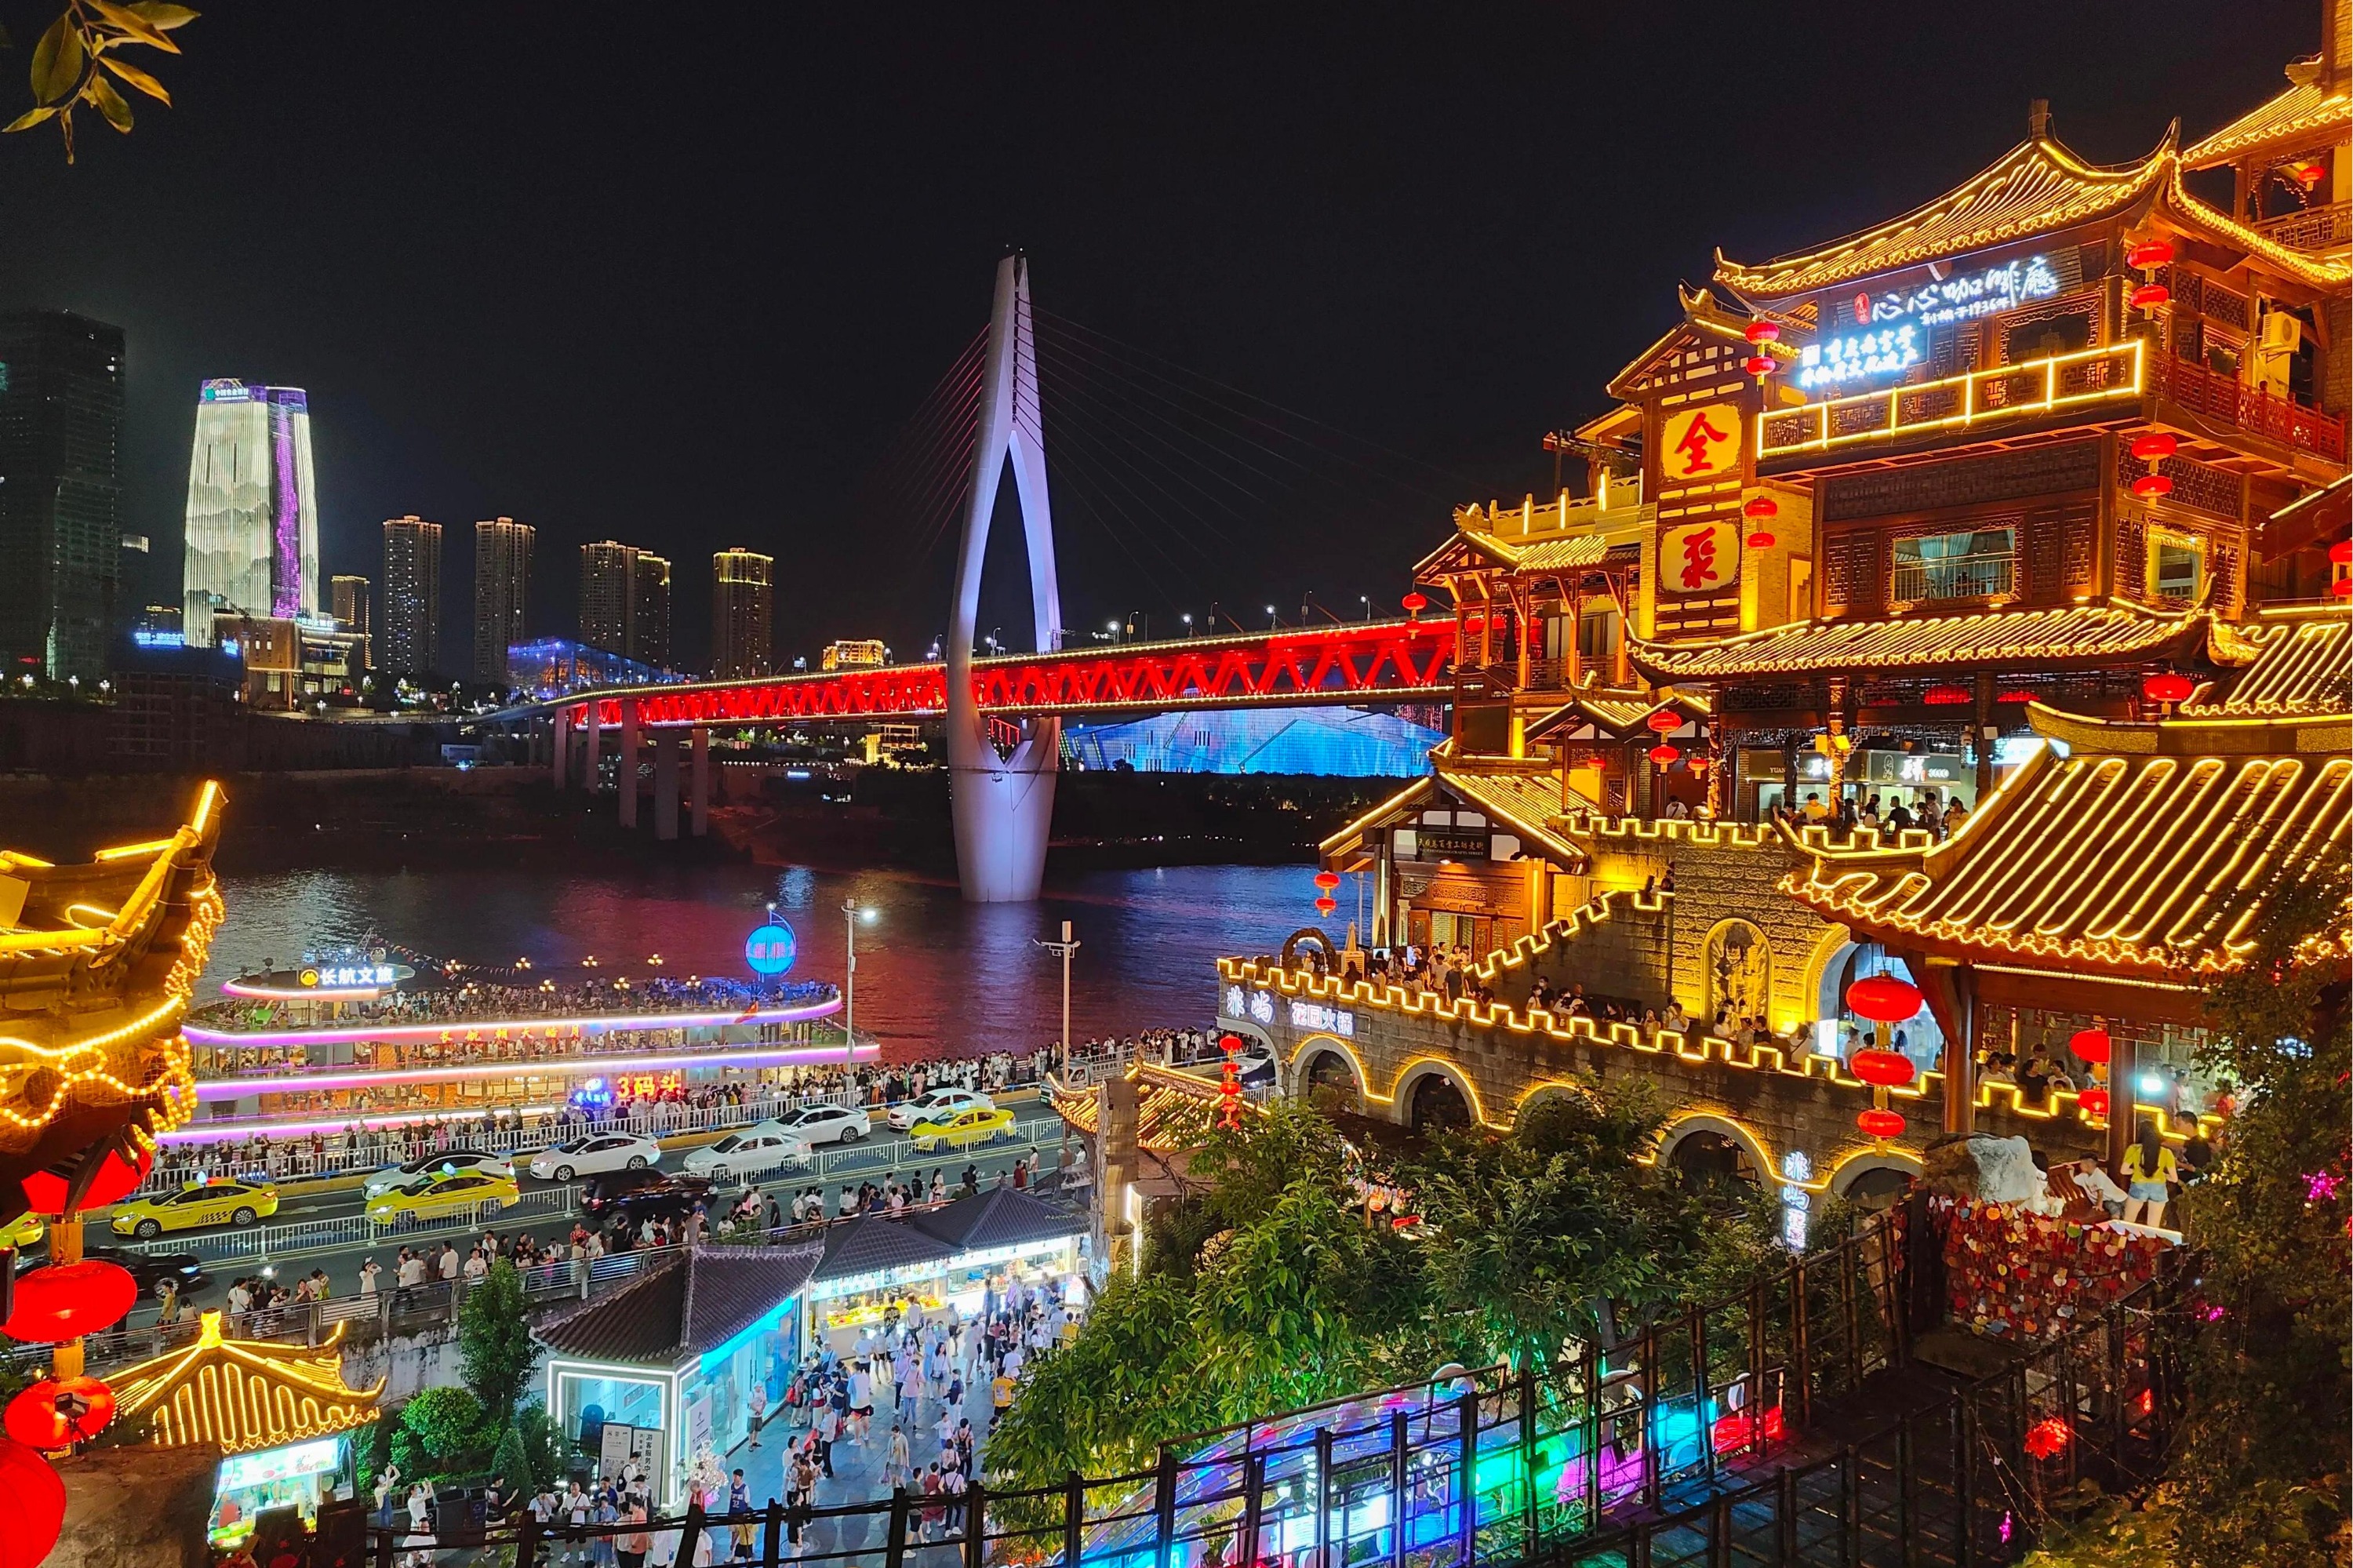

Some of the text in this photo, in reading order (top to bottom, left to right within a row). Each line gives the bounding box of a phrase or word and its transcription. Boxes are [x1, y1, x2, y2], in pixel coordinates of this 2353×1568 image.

[320, 966, 394, 985] 长航文旅
[1292, 1002, 1355, 1035] 花园火锅
[616, 1074, 682, 1097] 3码头
[644, 1434, 653, 1480] 游客服务中心
